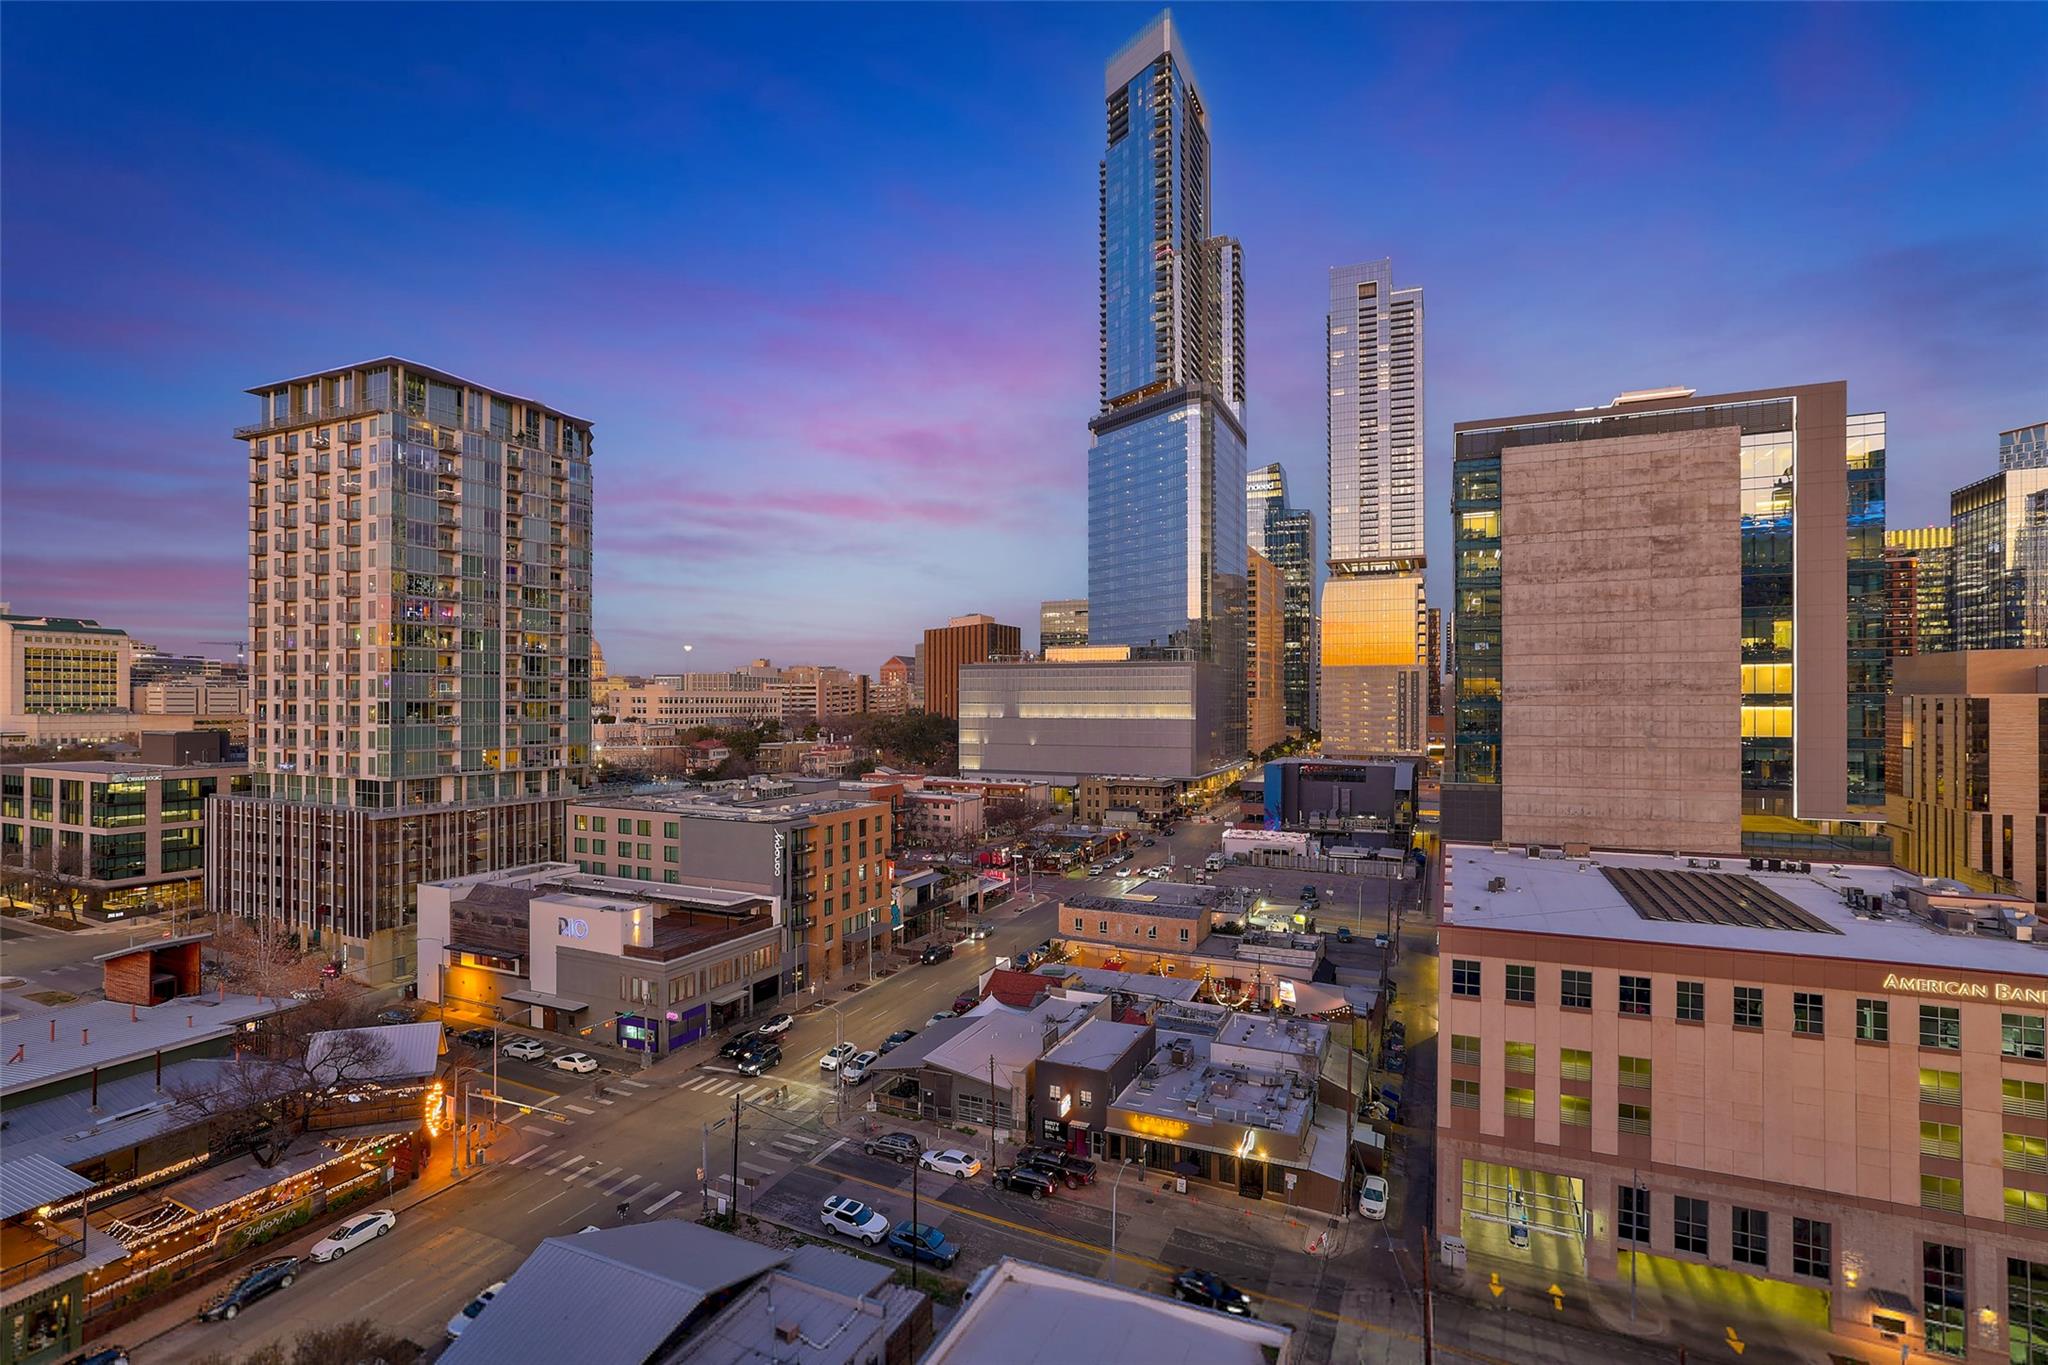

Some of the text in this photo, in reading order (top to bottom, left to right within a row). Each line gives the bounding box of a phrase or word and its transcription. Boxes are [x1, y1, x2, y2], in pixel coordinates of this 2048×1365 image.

[774, 828, 784, 877] canopy
[1883, 973, 1989, 999] AMERICAN
[1044, 1119, 1060, 1127] DIRTY
[1144, 1116, 1190, 1131] CARVER'S
